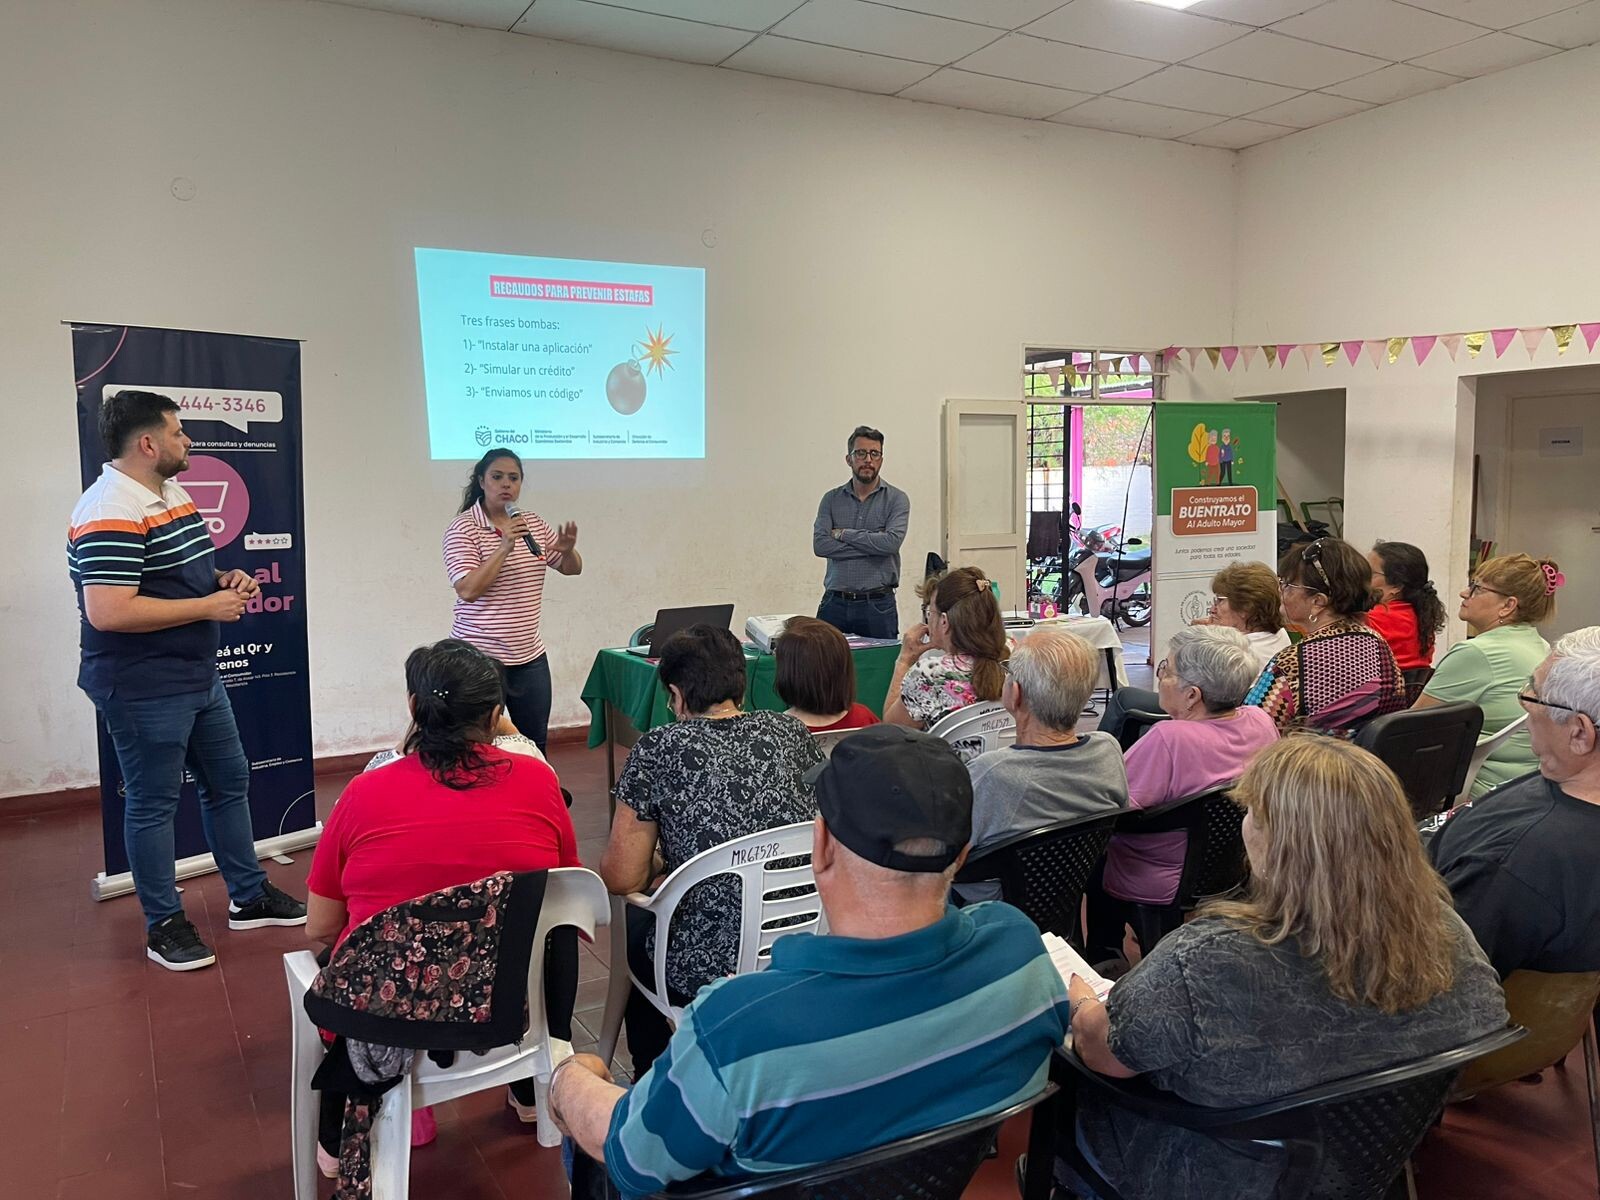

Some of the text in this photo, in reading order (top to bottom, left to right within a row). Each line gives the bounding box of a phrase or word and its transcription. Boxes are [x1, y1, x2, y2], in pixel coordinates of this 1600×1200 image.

[493, 281, 650, 303] RECAUDOS PARA PREVENIR ESTAFAS
[460, 315, 560, 330] Tres frases bombas:
[463, 339, 593, 356] 1)- "Instalar una aplicación"
[464, 363, 576, 377] 2)- "Simular un crédito"
[466, 386, 584, 401] 3)- "Enviamos un código"
[207, 440, 237, 448] consultas
[243, 441, 276, 449] denuncias
[495, 434, 529, 444] CHACO
[1189, 496, 1237, 505] Construyamos
[1179, 504, 1251, 519] BUENTRATO
[1186, 518, 1246, 529] Al Adulto Mayor
[254, 562, 282, 584] al
[244, 592, 295, 615] dor
[216, 643, 273, 658] eá el Qr y
